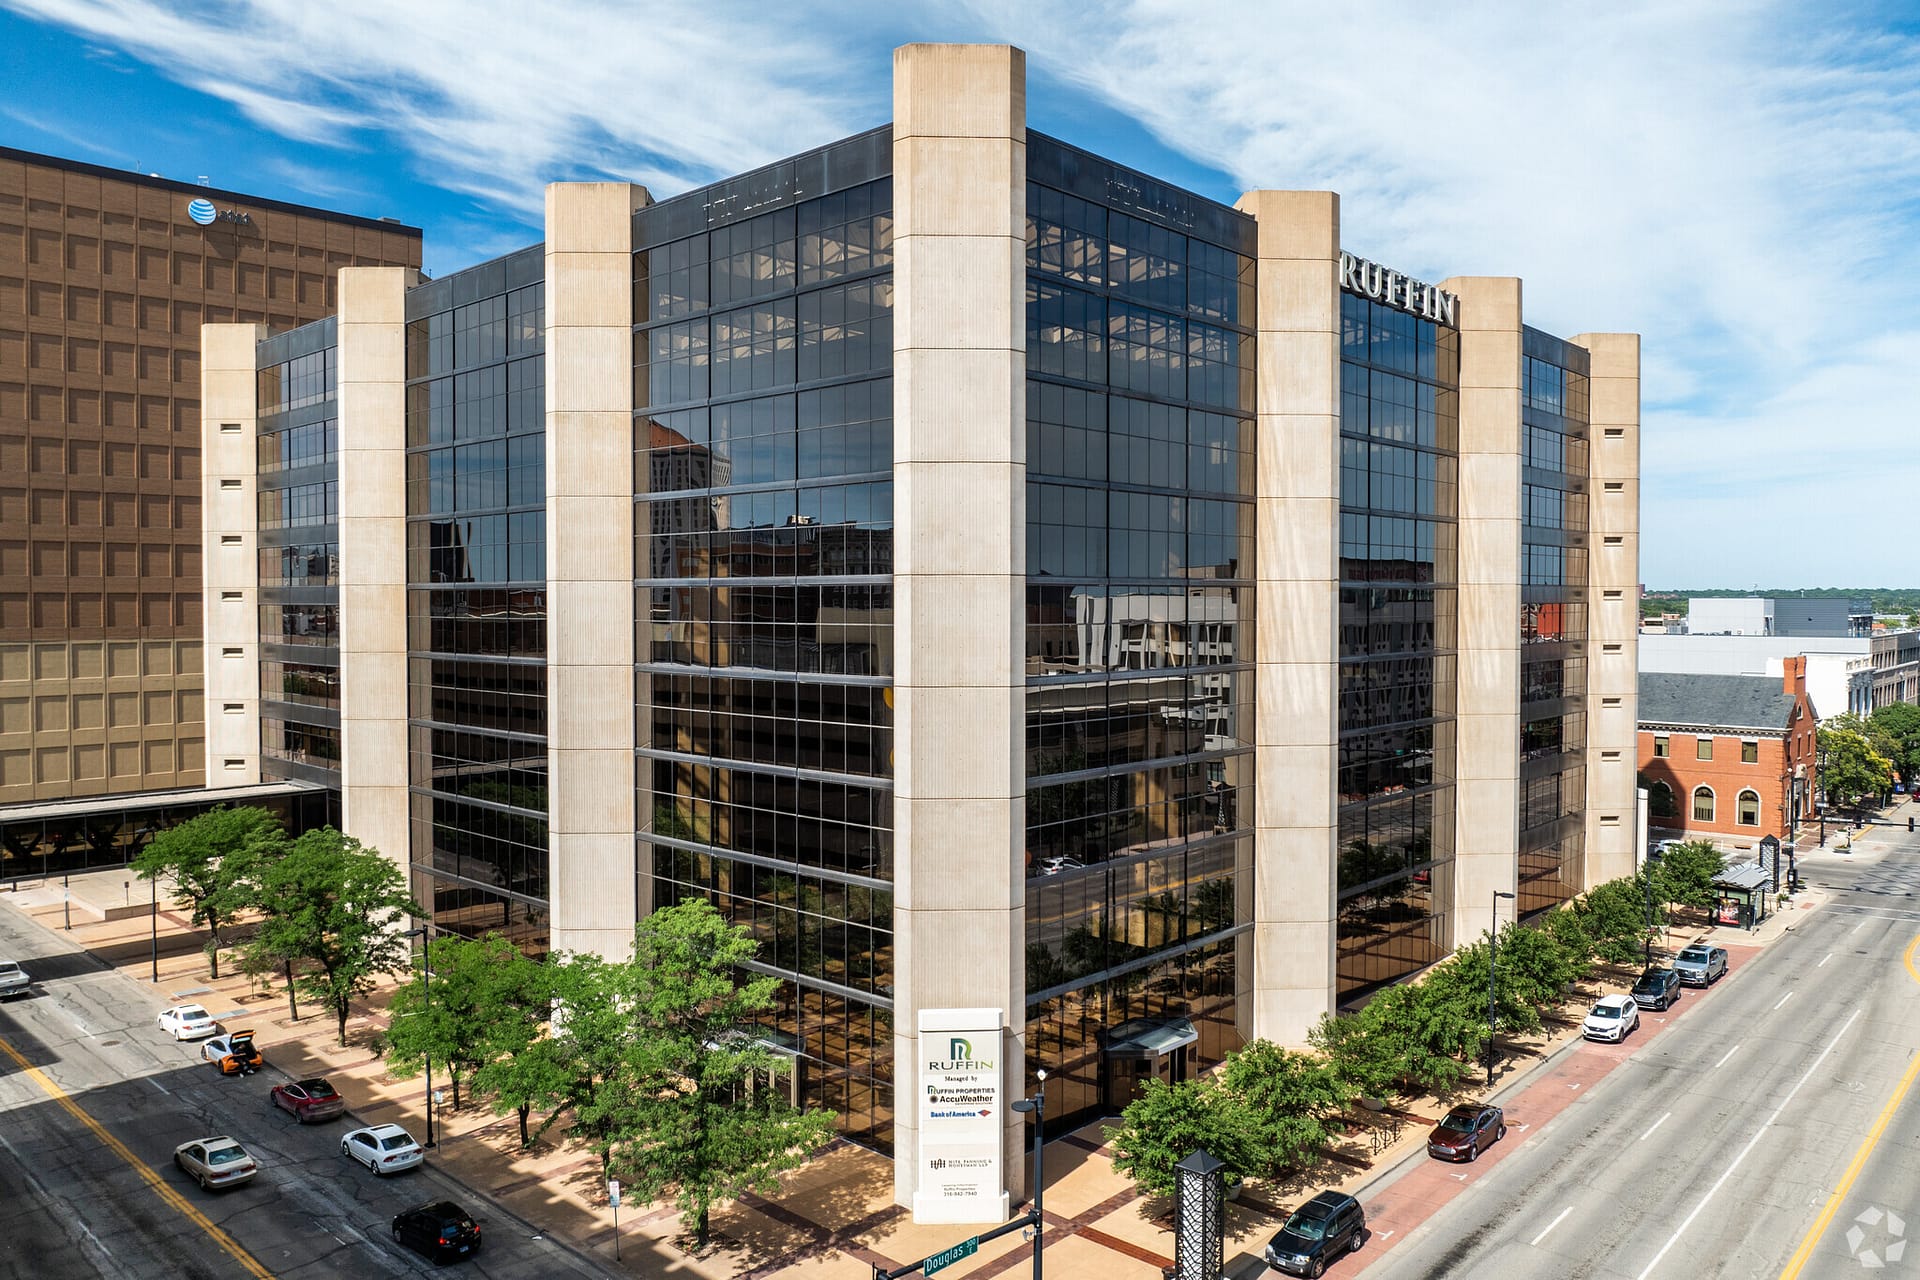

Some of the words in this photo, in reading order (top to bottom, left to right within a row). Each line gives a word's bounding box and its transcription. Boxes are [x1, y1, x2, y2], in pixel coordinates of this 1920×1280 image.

[1339, 248, 1457, 327] RUFFIN
[929, 1060, 993, 1071] RUFFIN
[944, 1075, 969, 1083] Managed
[955, 1087, 996, 1095] PROPERTIES
[939, 1095, 994, 1103] AccuWeather
[926, 1245, 963, 1272] Douglas
